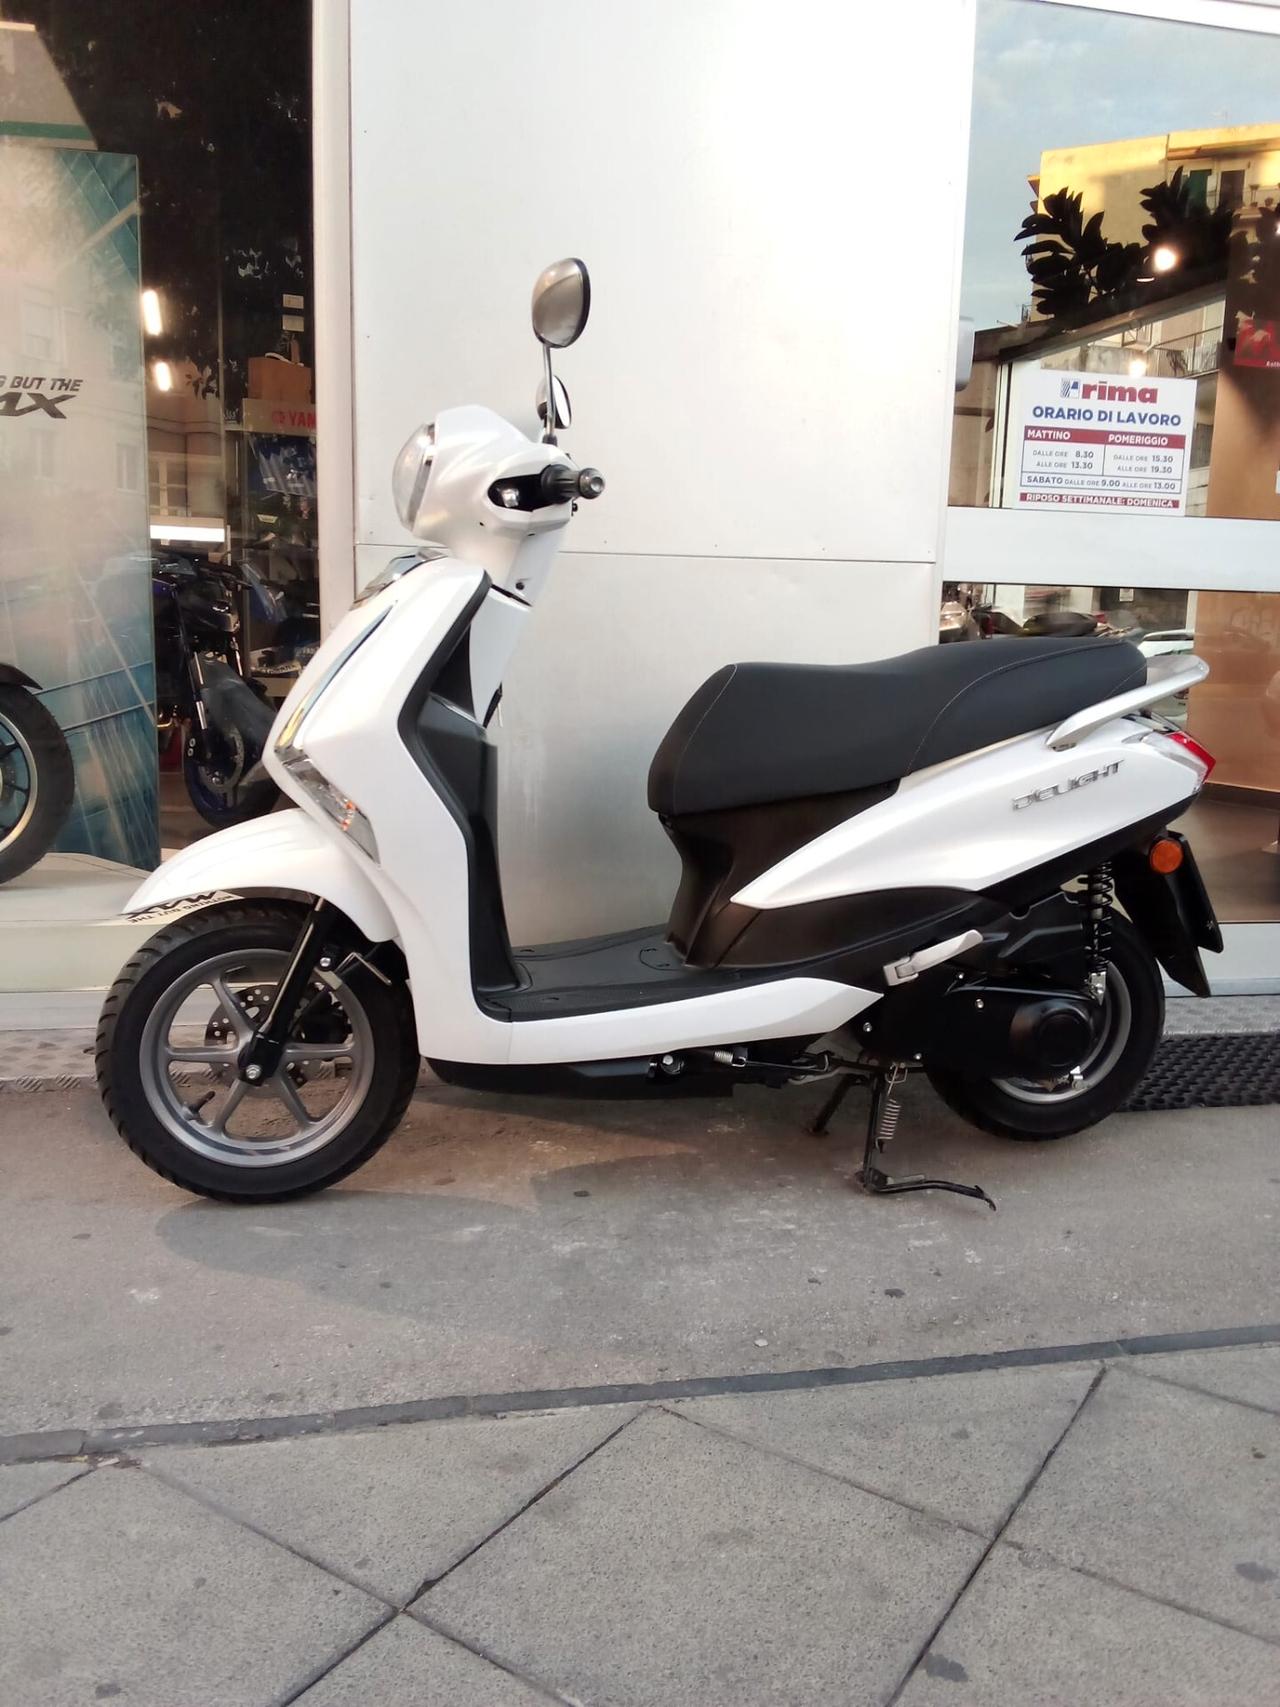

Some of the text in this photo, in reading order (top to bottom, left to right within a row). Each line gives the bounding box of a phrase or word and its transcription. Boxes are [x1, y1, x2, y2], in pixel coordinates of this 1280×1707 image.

[10, 376, 46, 390] BUT
[50, 378, 83, 392] THE
[1032, 406, 1181, 427] ORARIO DI LAVORO
[1027, 429, 1071, 440] MATTINO
[1108, 434, 1168, 446] POMERIGGIO
[1075, 450, 1094, 459] 8.30
[1113, 454, 1133, 462] DALLE
[1152, 454, 1174, 463] 15.30
[1071, 461, 1093, 470] 13.30
[1151, 465, 1172, 474] 19.30
[1026, 475, 1063, 484] SABATO
[1101, 479, 1120, 487] 9.00
[1154, 482, 1176, 490] 13.00
[1026, 493, 1174, 507] RIPOSO SETTIMANALE: DOMENICA
